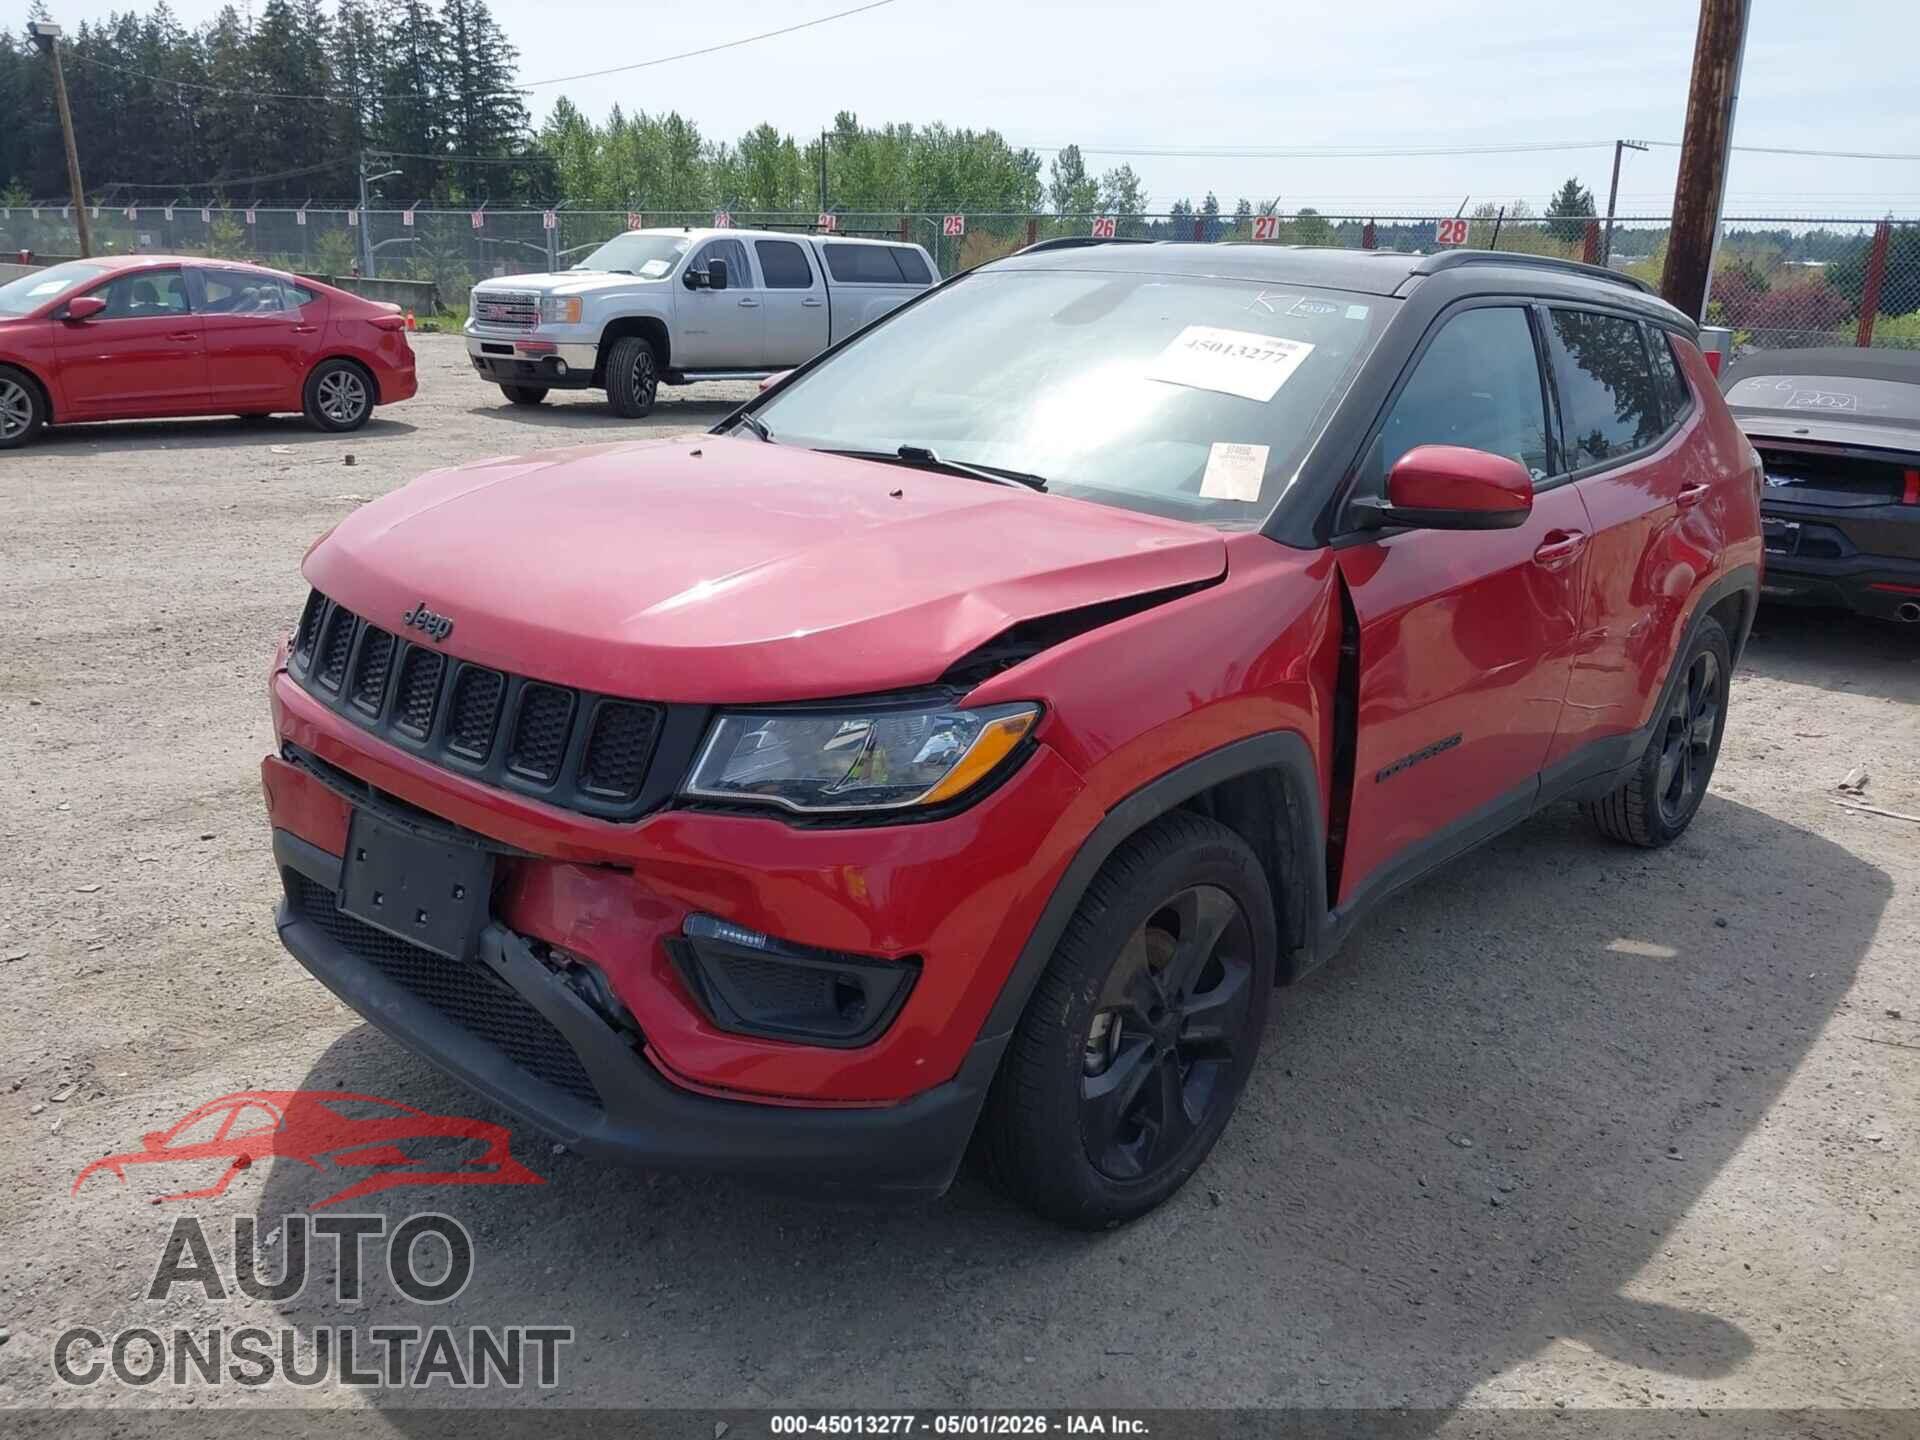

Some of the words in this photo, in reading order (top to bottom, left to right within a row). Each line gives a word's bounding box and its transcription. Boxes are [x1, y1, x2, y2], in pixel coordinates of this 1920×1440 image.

[629, 213, 641, 229] 22
[945, 216, 963, 234] 25
[1093, 218, 1114, 238] 26
[1255, 217, 1277, 240] 27
[1438, 220, 1467, 243] 28
[403, 601, 453, 641] Jeep
